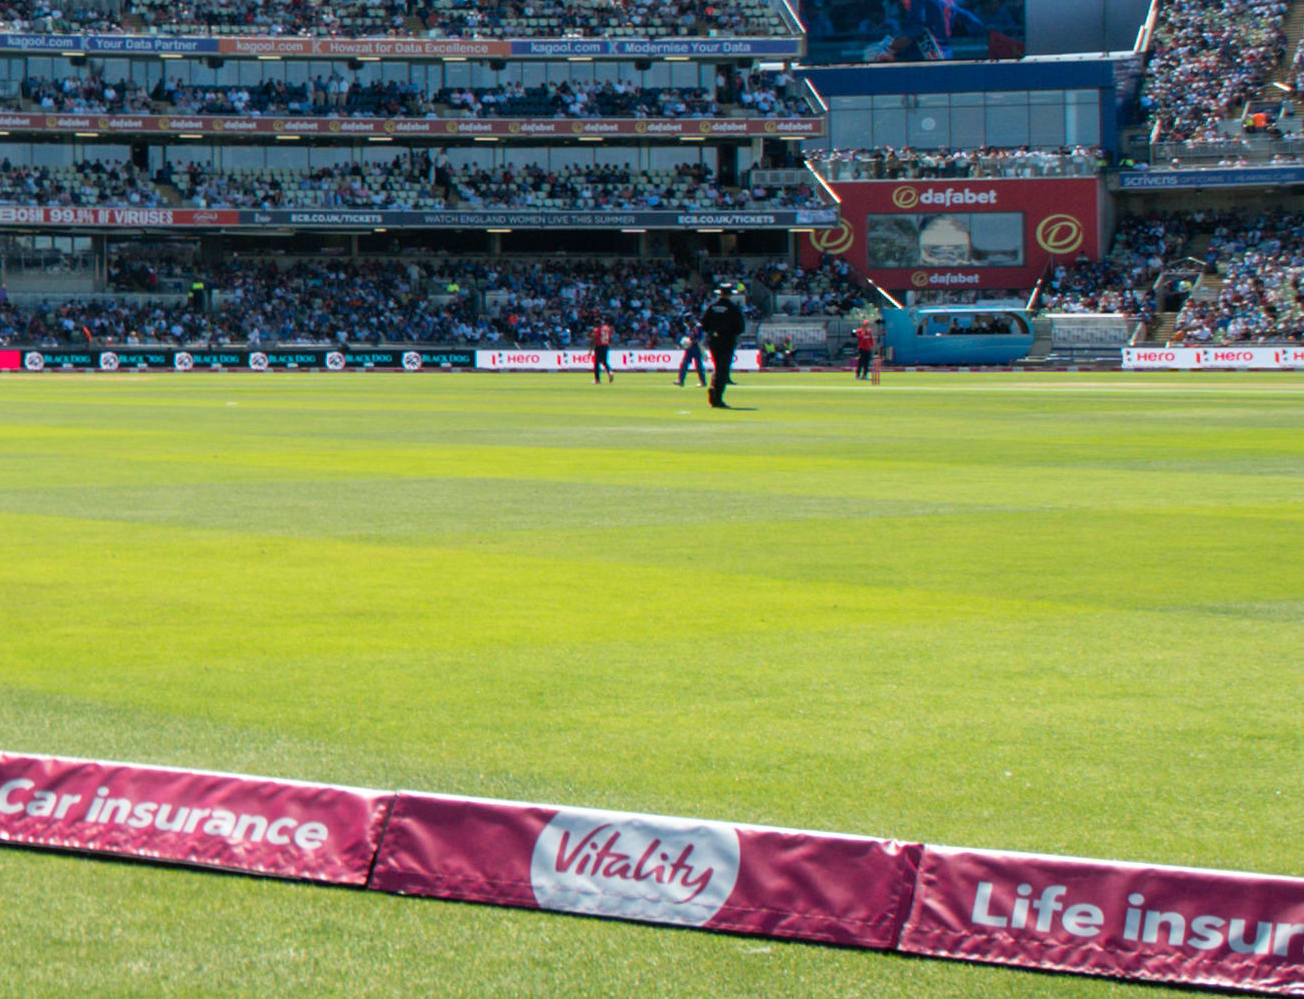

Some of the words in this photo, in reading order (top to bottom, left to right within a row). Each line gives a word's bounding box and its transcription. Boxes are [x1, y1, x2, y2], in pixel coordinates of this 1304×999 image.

[7, 36, 73, 50] kagool.com
[96, 38, 122, 49] Your
[125, 39, 152, 49] Data
[154, 39, 198, 50] Partner
[236, 41, 303, 52] kagool.com
[330, 42, 370, 53] Howzat
[373, 42, 391, 53] for
[395, 42, 423, 53] Data
[425, 42, 488, 53] Excellence
[531, 42, 600, 54] kagool.com
[625, 42, 690, 53] Modernise
[691, 42, 720, 53] Your
[722, 42, 751, 52] Data
[920, 188, 997, 207] dafabet
[50, 209, 94, 222] 99.9%
[98, 210, 110, 223] OF
[114, 210, 173, 224] VIRUSES
[292, 214, 383, 223] ECB.CO.UK/TICKETS
[425, 215, 458, 223] WATCH
[460, 215, 507, 223] ENGLAND
[509, 215, 546, 223] WOMEN
[548, 216, 569, 224] LIVE
[570, 216, 592, 224] THIS
[594, 216, 635, 224] SUMMER
[678, 215, 775, 224] ECB.CO.UK/TICKETS
[929, 272, 980, 286] dafabet
[85, 786, 329, 850] insurance
[555, 822, 715, 905] Vitality
[971, 881, 1102, 937] Life
